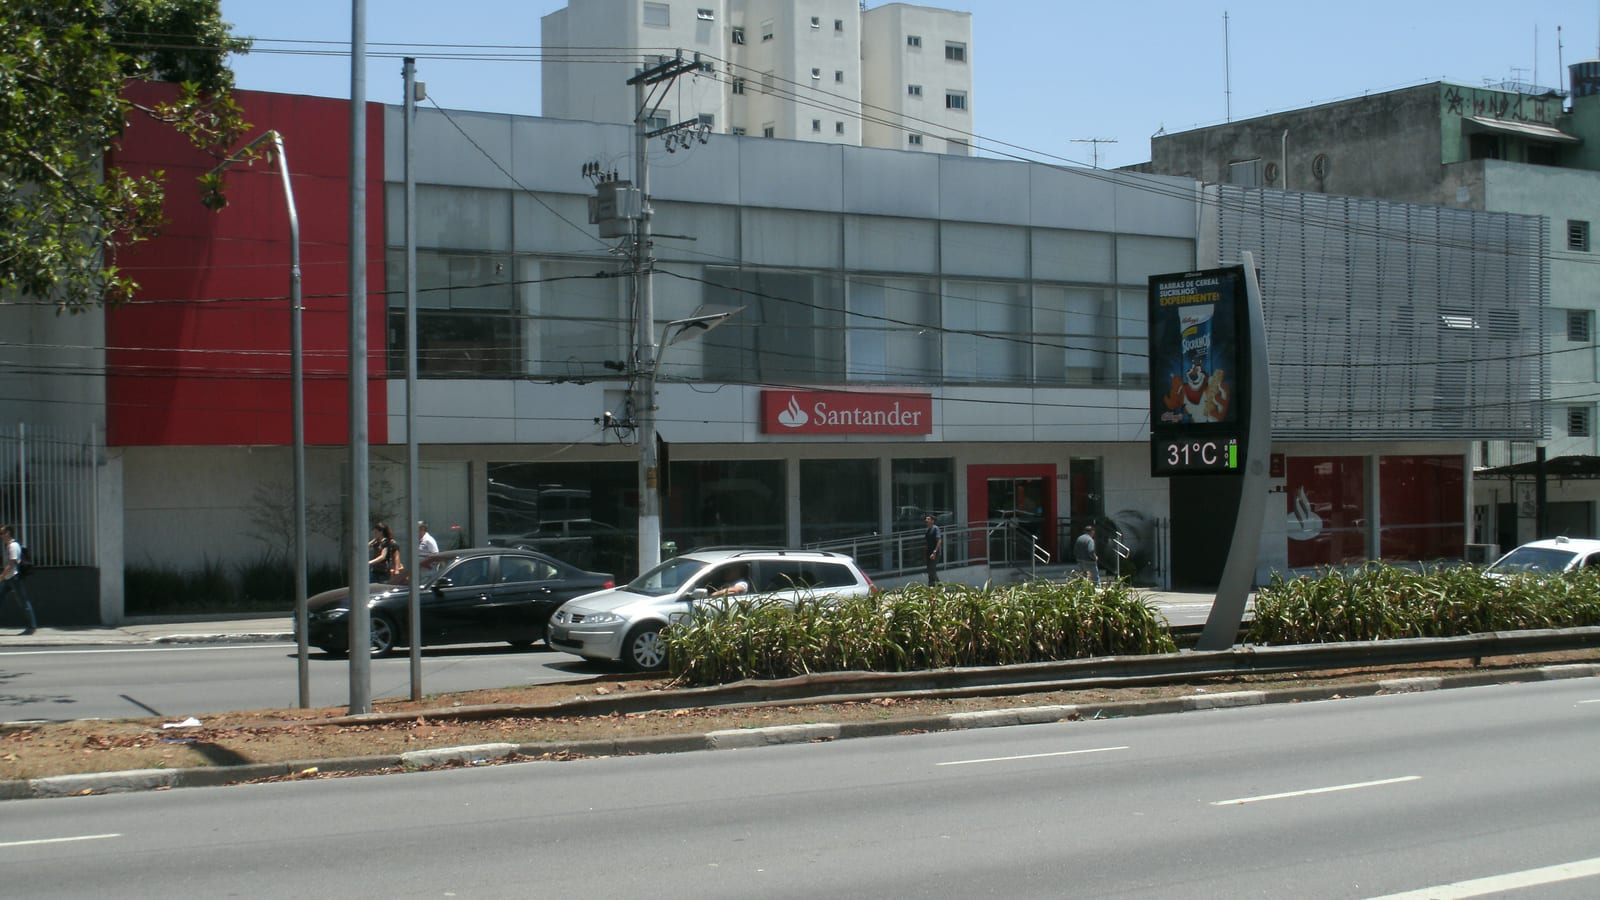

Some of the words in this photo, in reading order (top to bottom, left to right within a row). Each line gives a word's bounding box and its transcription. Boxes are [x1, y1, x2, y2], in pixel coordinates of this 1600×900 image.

[1160, 281, 1185, 290] BARRAS
[1195, 278, 1219, 287] CEREAL
[1160, 291, 1220, 306] EXPERIMENTE!
[814, 402, 922, 426] Santander
[1167, 442, 1217, 466] 31°C
